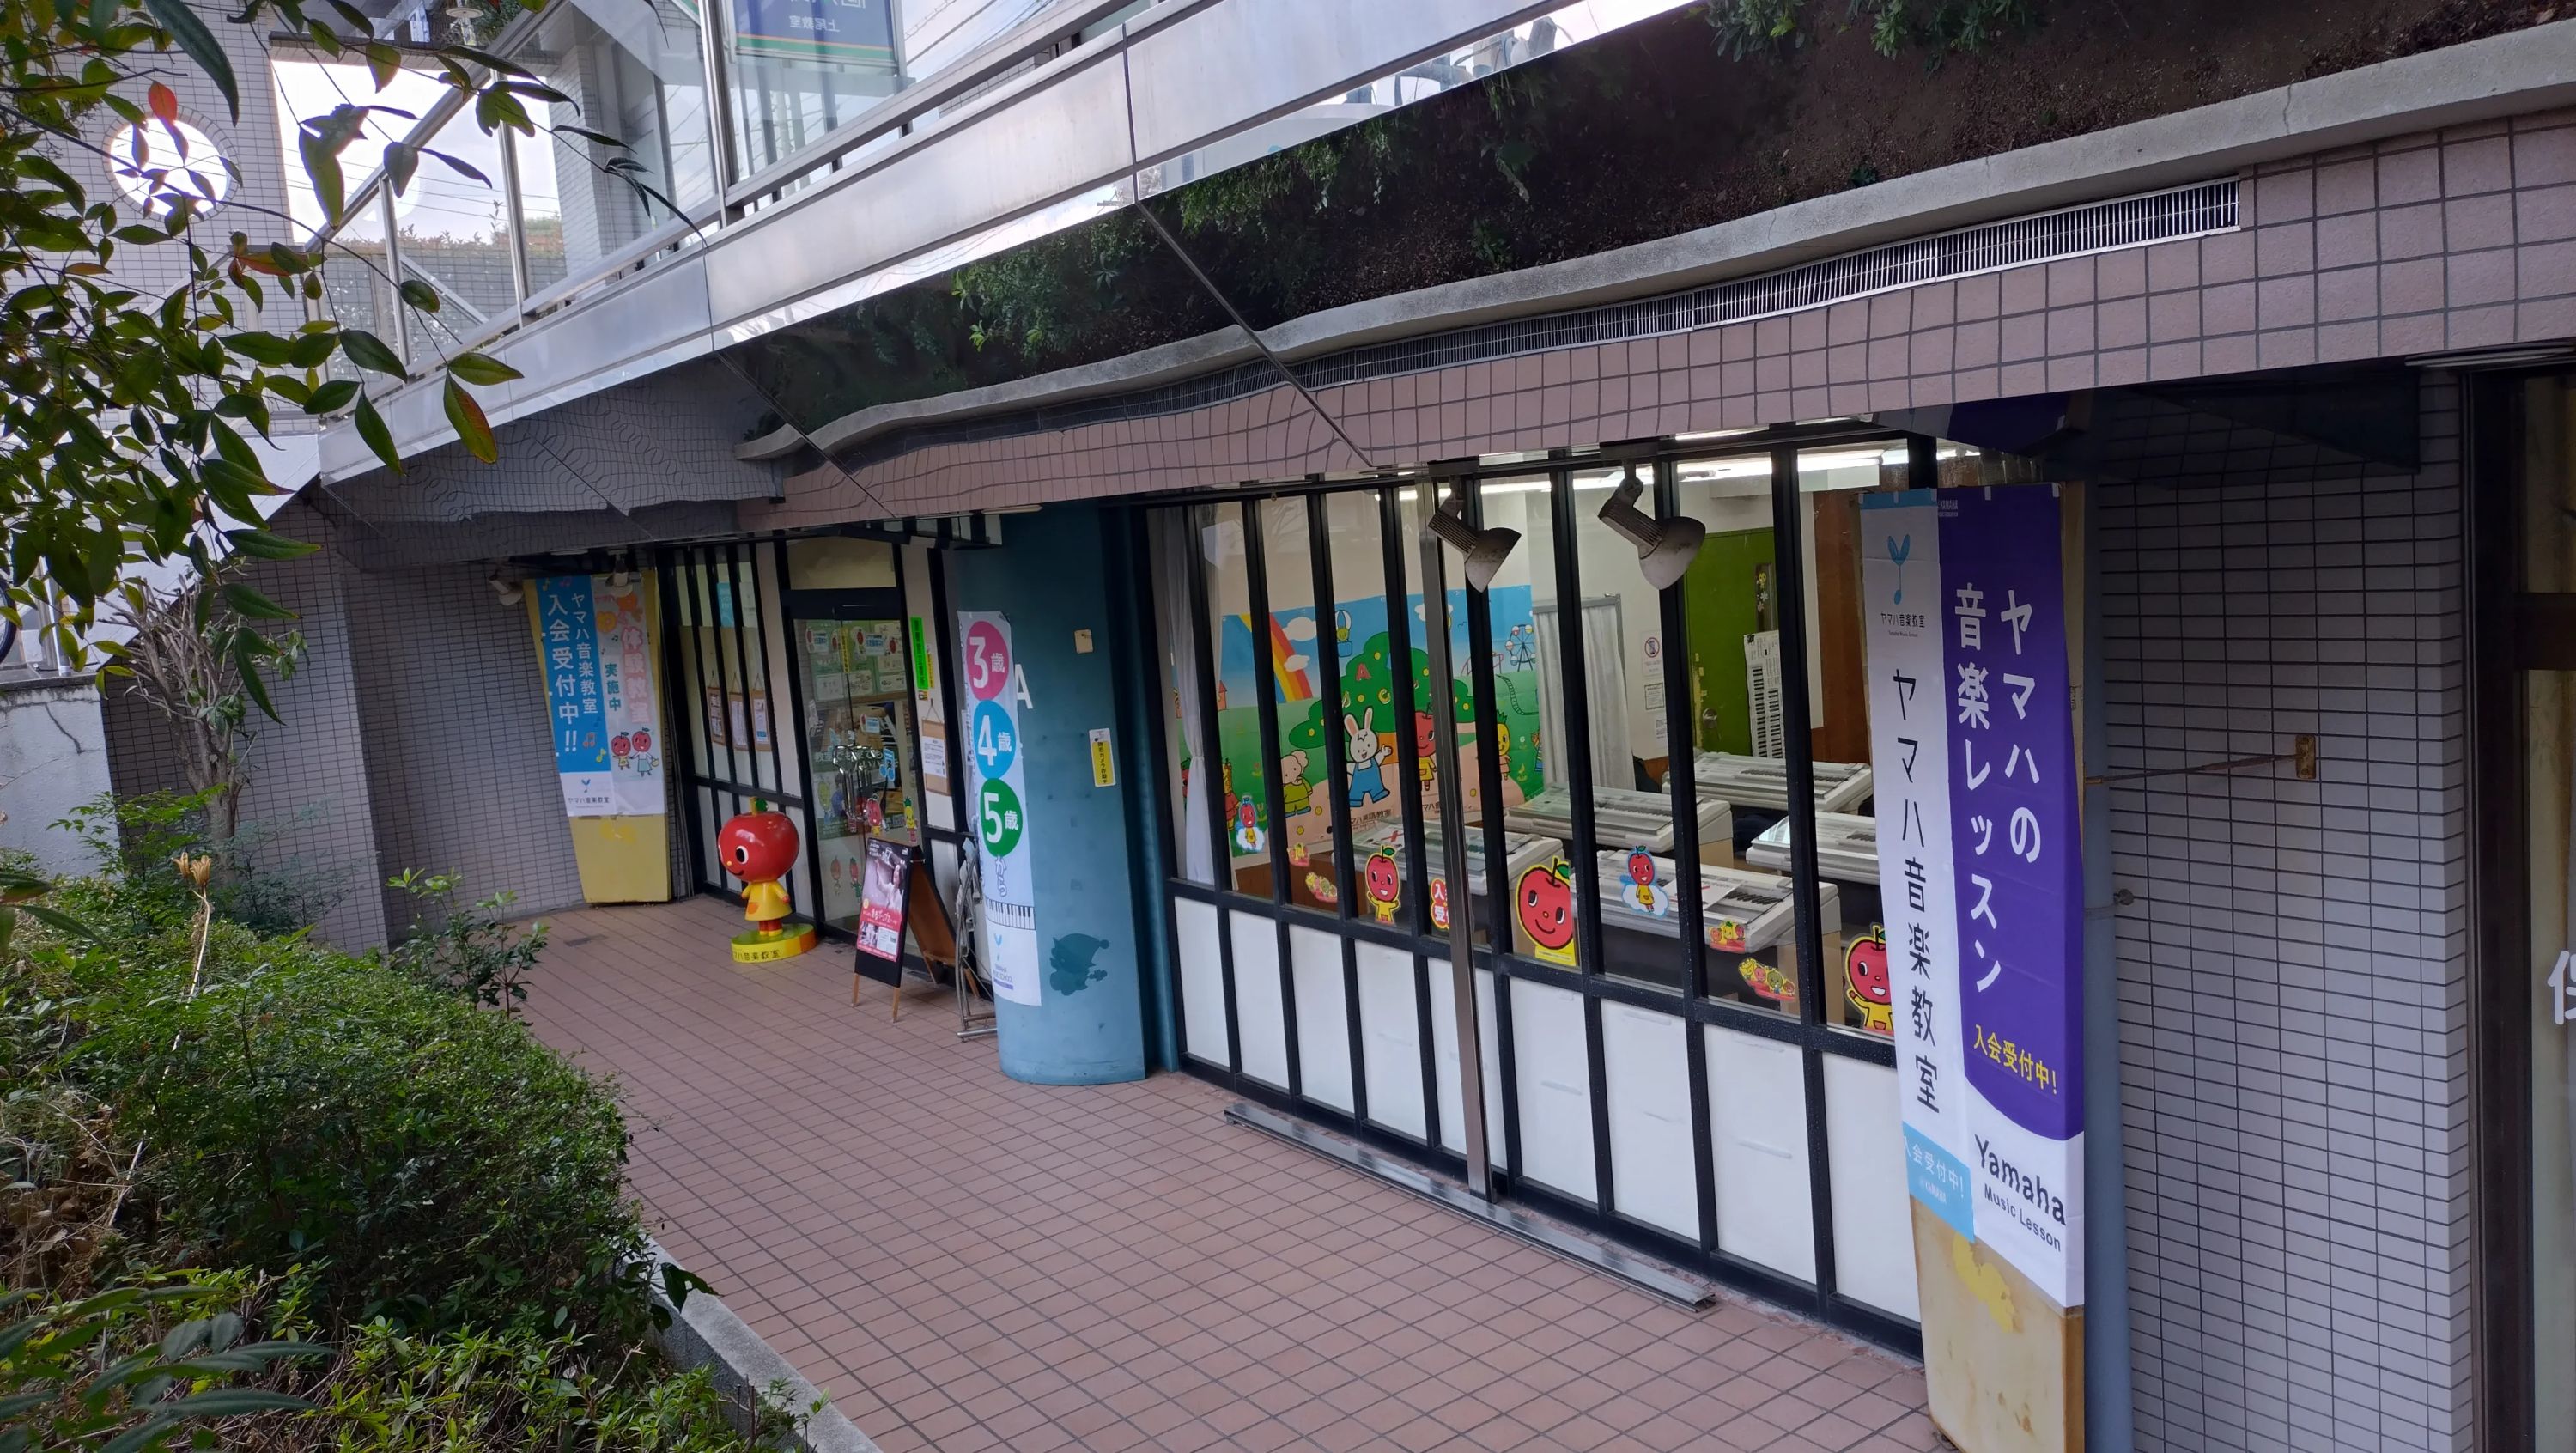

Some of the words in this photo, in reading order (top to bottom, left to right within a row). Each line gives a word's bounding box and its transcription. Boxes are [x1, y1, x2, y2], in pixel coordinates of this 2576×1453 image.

[1880, 612, 1925, 629] ヤマハ音楽教室
[548, 594, 580, 752] 入会受付中!!
[571, 593, 598, 714] ヤマハ音楽教室
[622, 626, 652, 724] 体験教室
[969, 636, 1005, 689] 3歳
[1355, 663, 1372, 682] A
[605, 663, 622, 712] 実施中
[977, 714, 1012, 766] 4歳
[2000, 589, 2041, 864] ヤマハの
[983, 792, 1019, 843] 5歳
[1953, 581, 2002, 994] 音楽レッスン
[995, 857, 1008, 897] から
[1435, 883, 1448, 901] 入
[1892, 667, 1941, 1114] ヤマハ音楽教室
[1434, 905, 1449, 924] 受
[1973, 1023, 2058, 1095] 入会受付中!
[1974, 1133, 2067, 1226] Yamaha
[1984, 1182, 2016, 1218] Music
[2019, 1207, 2062, 1253] Lesson
